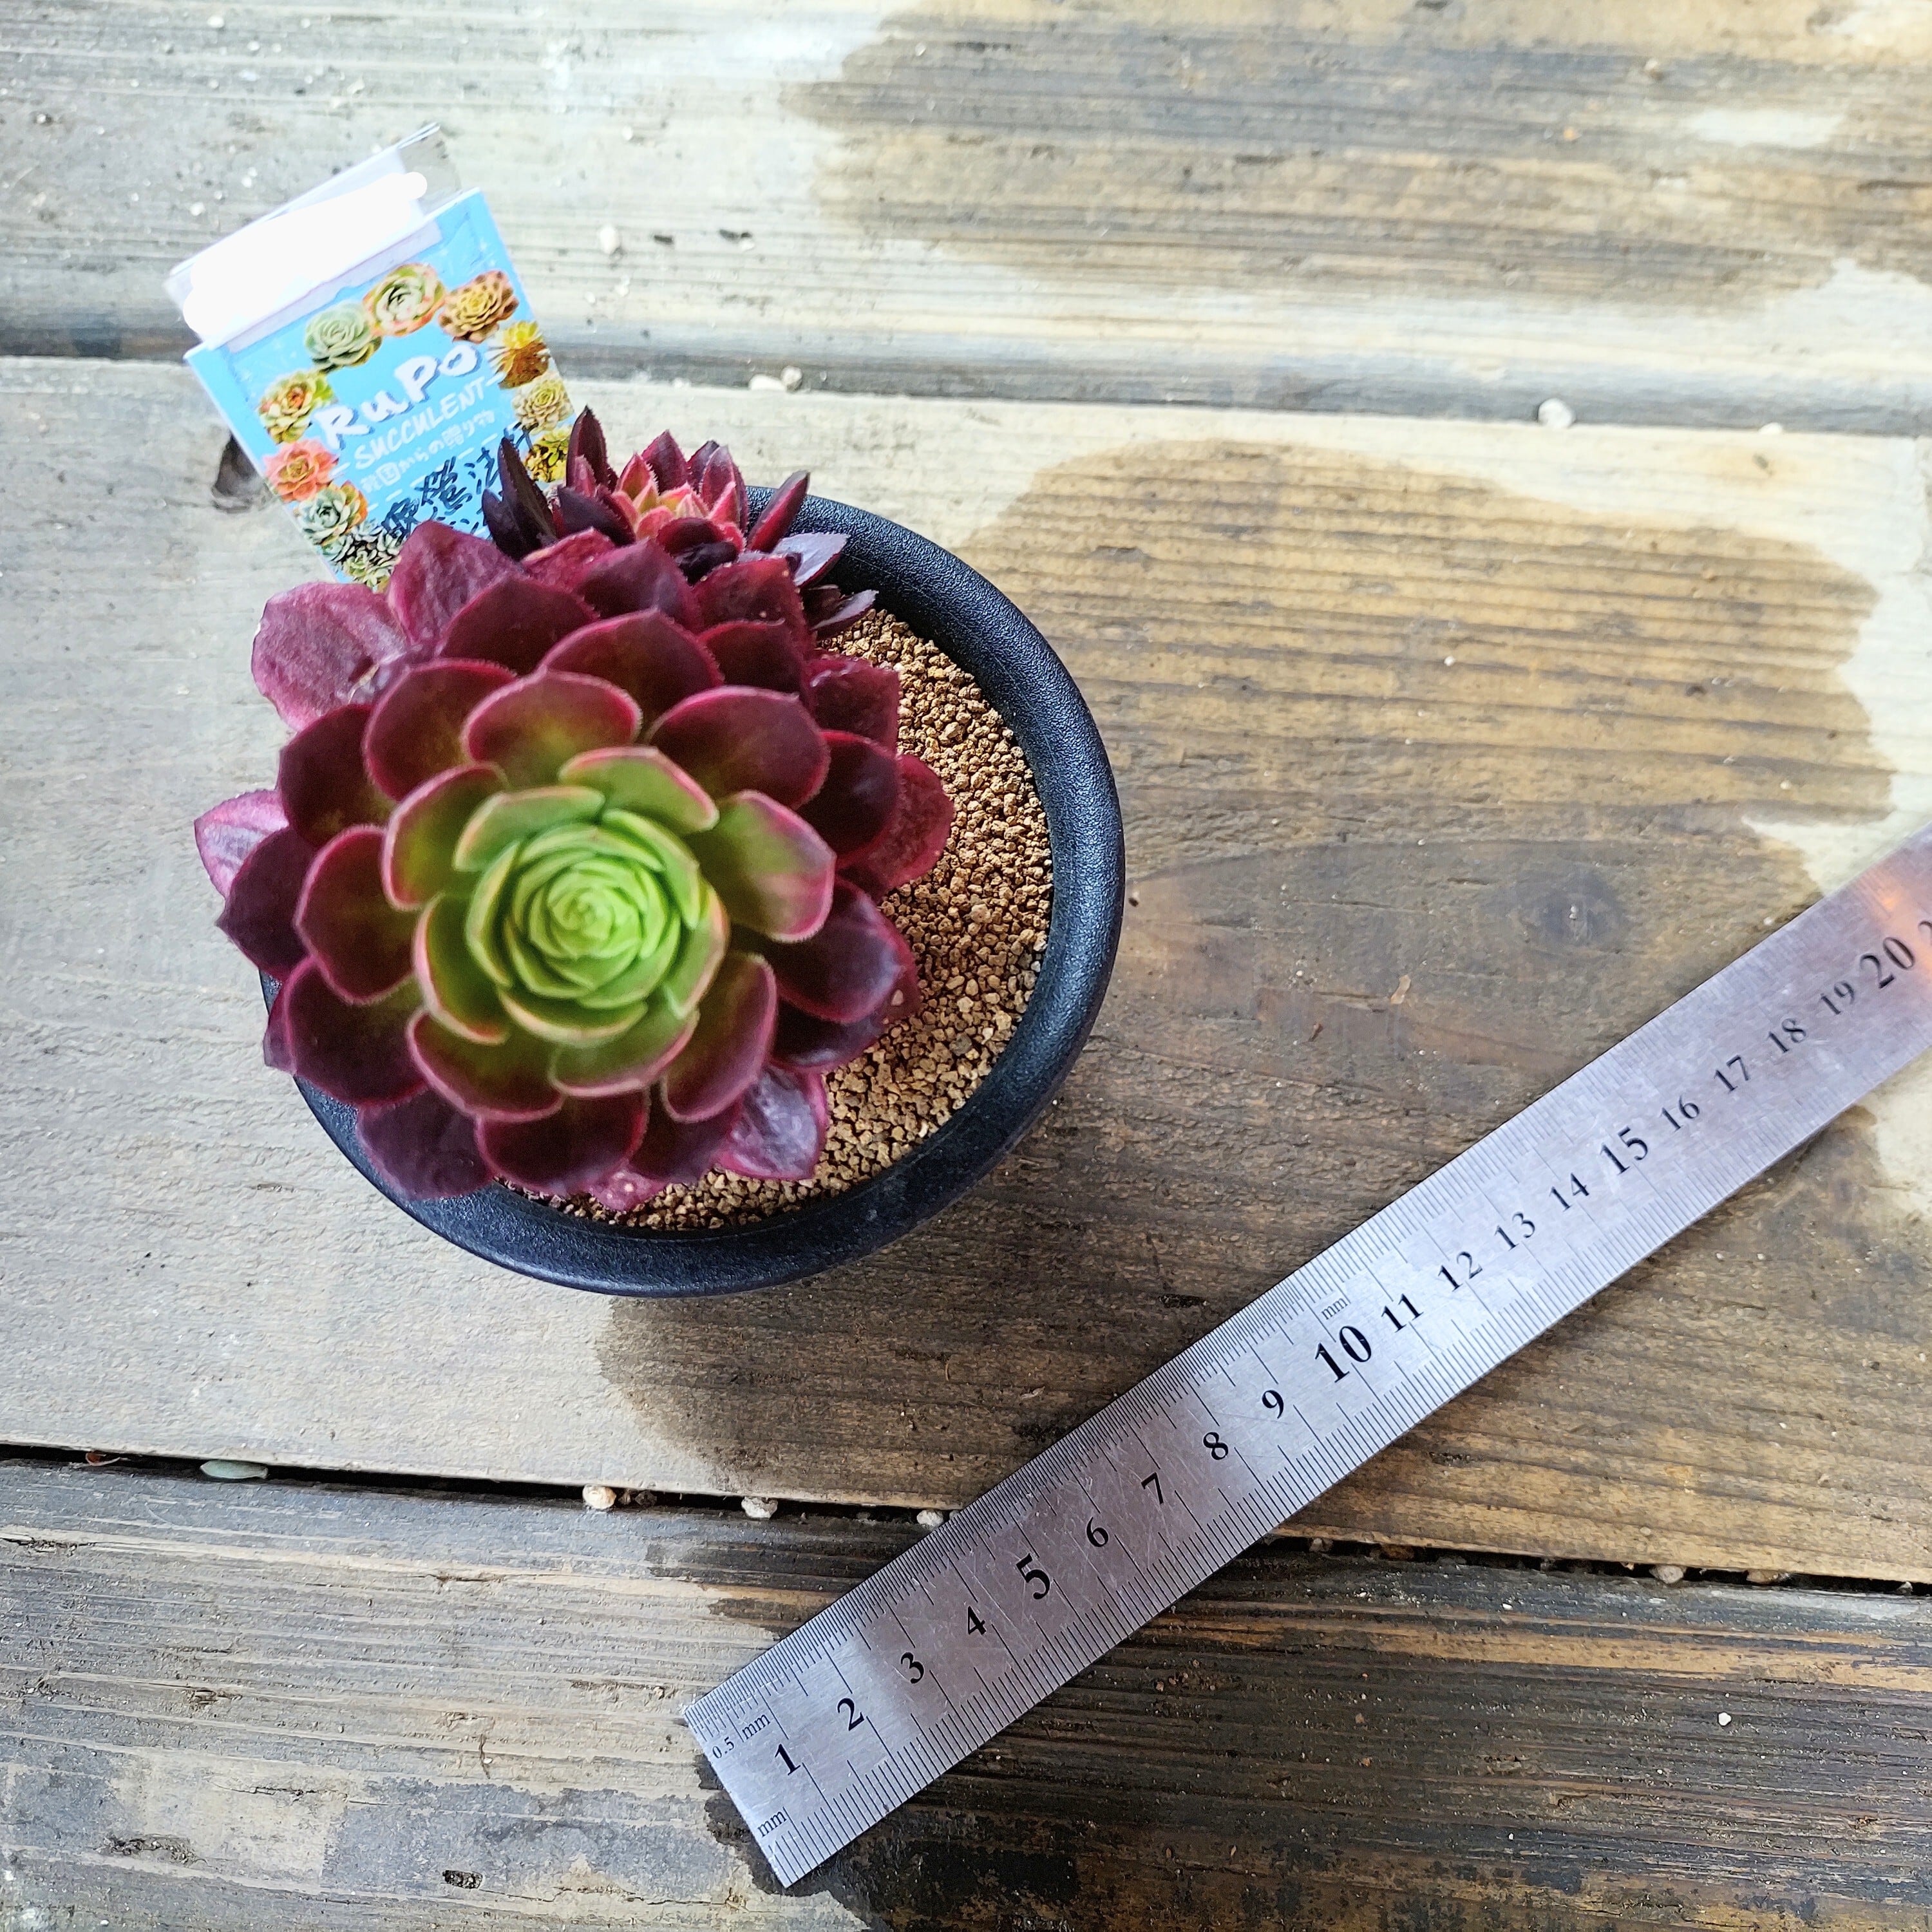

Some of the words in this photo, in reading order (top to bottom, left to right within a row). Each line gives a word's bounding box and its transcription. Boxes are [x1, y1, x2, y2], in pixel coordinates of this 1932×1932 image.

[354, 378, 488, 470] SUCCULENT
[1321, 1296, 1348, 1320] mm
[774, 1743, 802, 1776] 1
[837, 1698, 865, 1730] 2
[900, 1651, 925, 1683] 3
[965, 1607, 987, 1638] 4
[1015, 1553, 1050, 1600] 5
[1086, 1517, 1108, 1548] 6
[1141, 1472, 1164, 1504] 7
[1202, 1432, 1229, 1460] 8
[1262, 1389, 1284, 1418] 9
[1314, 1326, 1372, 1383] 10
[1381, 1293, 1424, 1332] 11
[1437, 1251, 1482, 1291] 12
[1493, 1213, 1536, 1251] 13
[1548, 1173, 1590, 1211] 14
[1599, 1127, 1649, 1175] 15
[1659, 1095, 1701, 1132] 16
[1712, 1054, 1752, 1092] 17
[1767, 1018, 1806, 1054] 18
[1819, 980, 1855, 1015] 19
[1859, 936, 1915, 989] 20
[712, 1741, 735, 1759] 0.5
[741, 1713, 772, 1740] mm
[757, 1810, 787, 1838] mm
